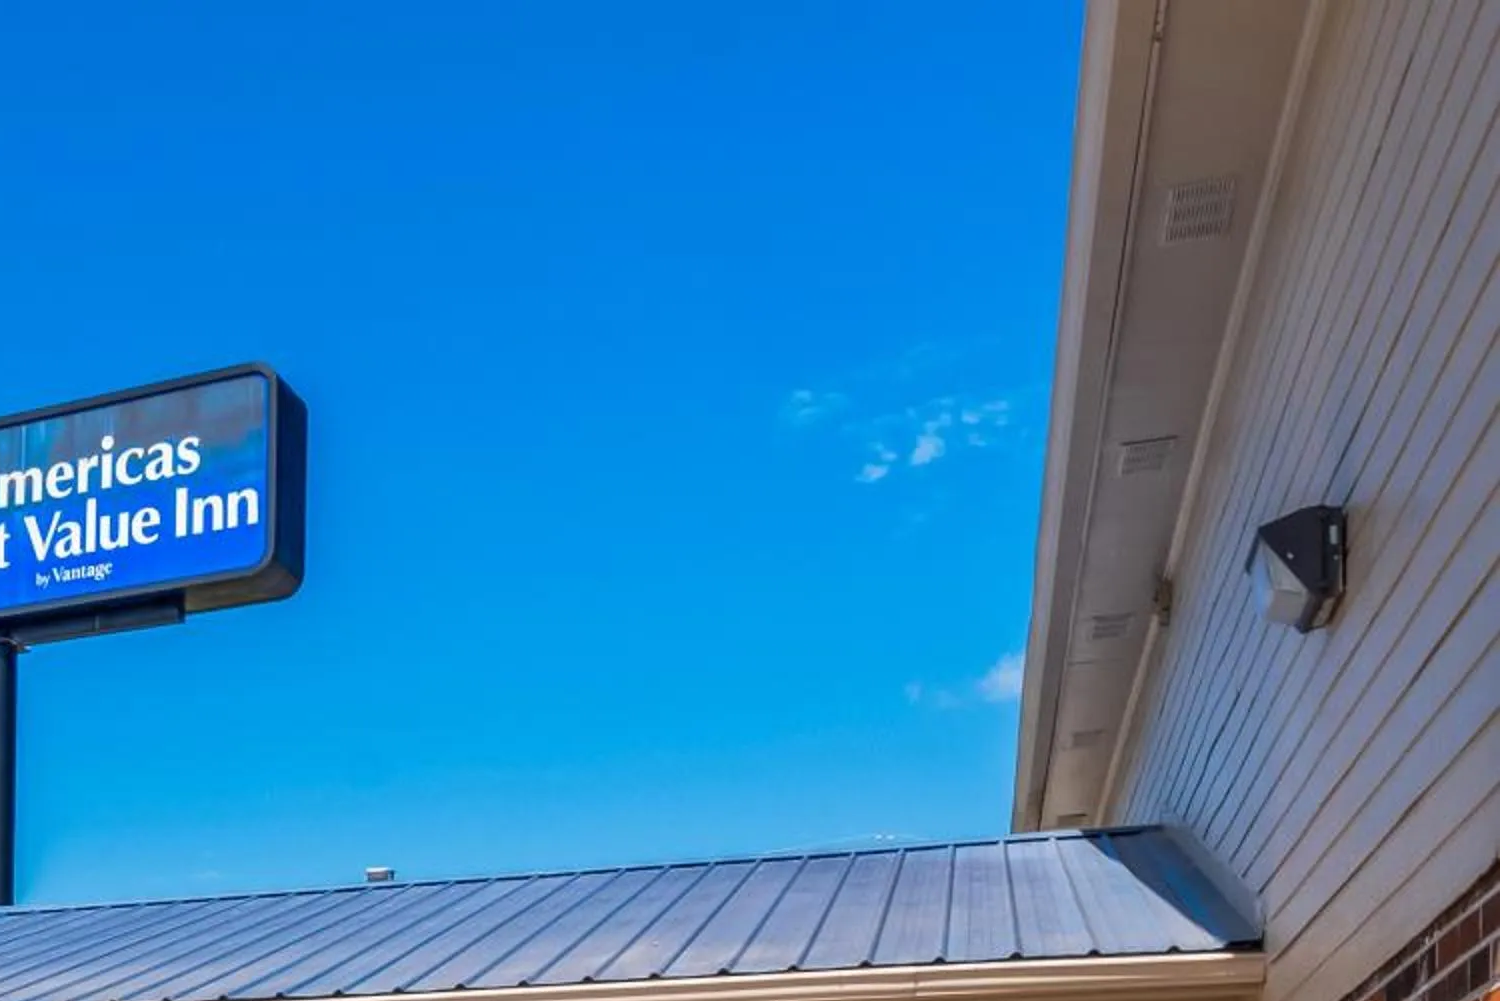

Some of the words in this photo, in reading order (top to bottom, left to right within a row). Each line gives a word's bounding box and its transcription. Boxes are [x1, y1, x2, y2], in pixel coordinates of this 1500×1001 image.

[23, 497, 161, 562] Value
[175, 487, 259, 538] Inn
[35, 572, 50, 589] by
[51, 561, 113, 582] Vantage
